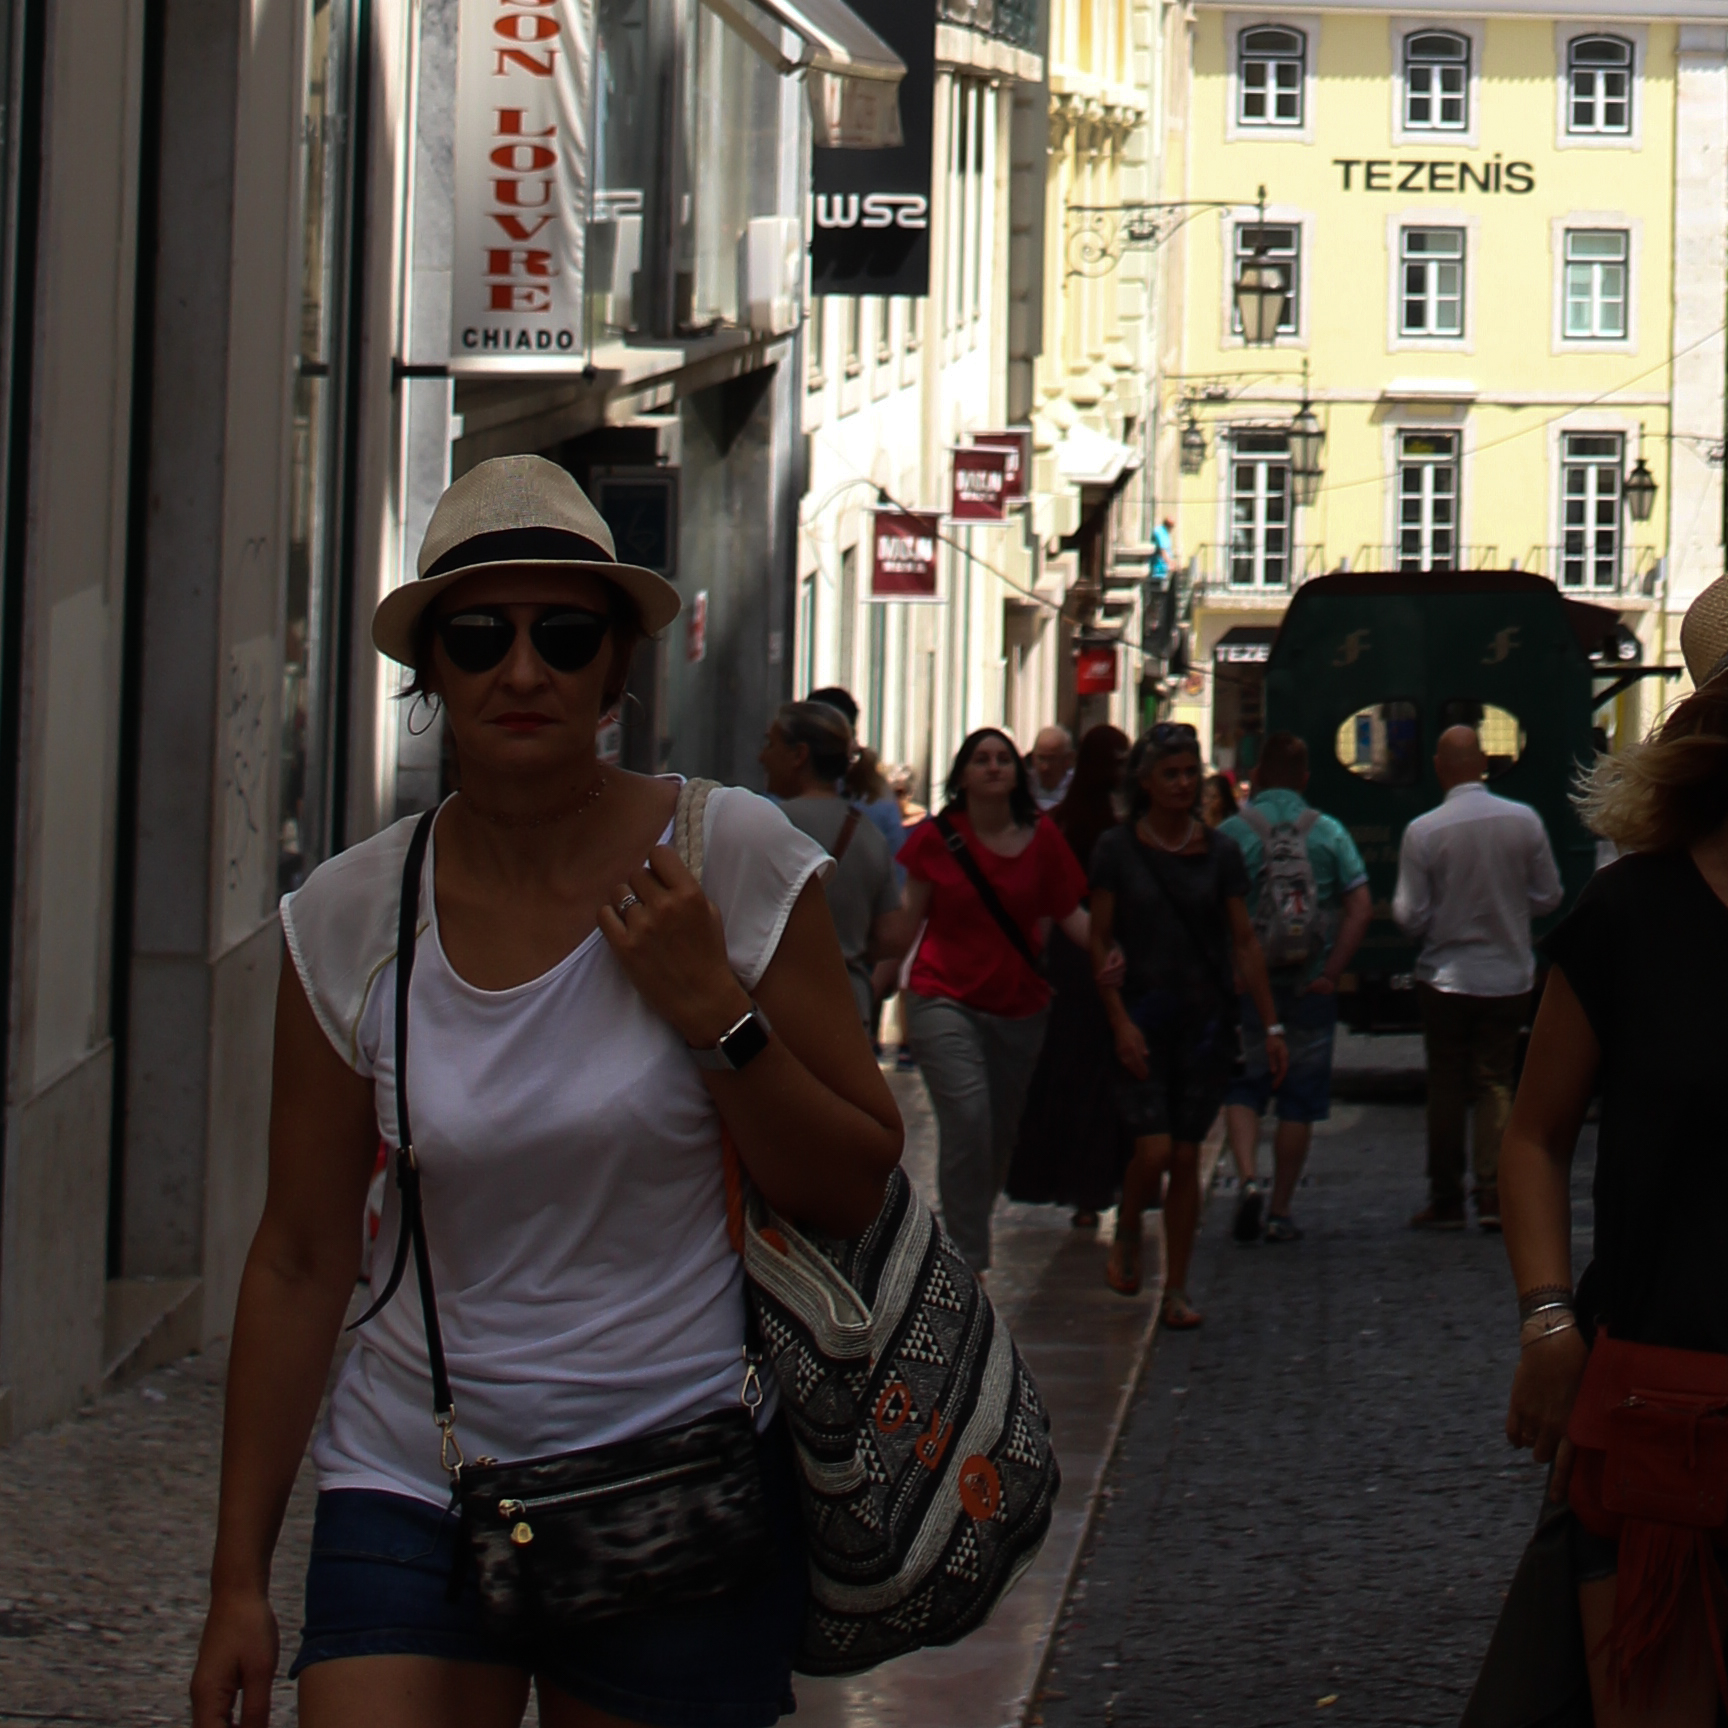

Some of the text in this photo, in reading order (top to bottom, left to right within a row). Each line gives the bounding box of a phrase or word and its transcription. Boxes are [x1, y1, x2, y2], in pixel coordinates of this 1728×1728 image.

[483, 108, 560, 313] LOUVRE
[461, 327, 574, 351] CHIADO
[1216, 645, 1270, 663] TEZE
